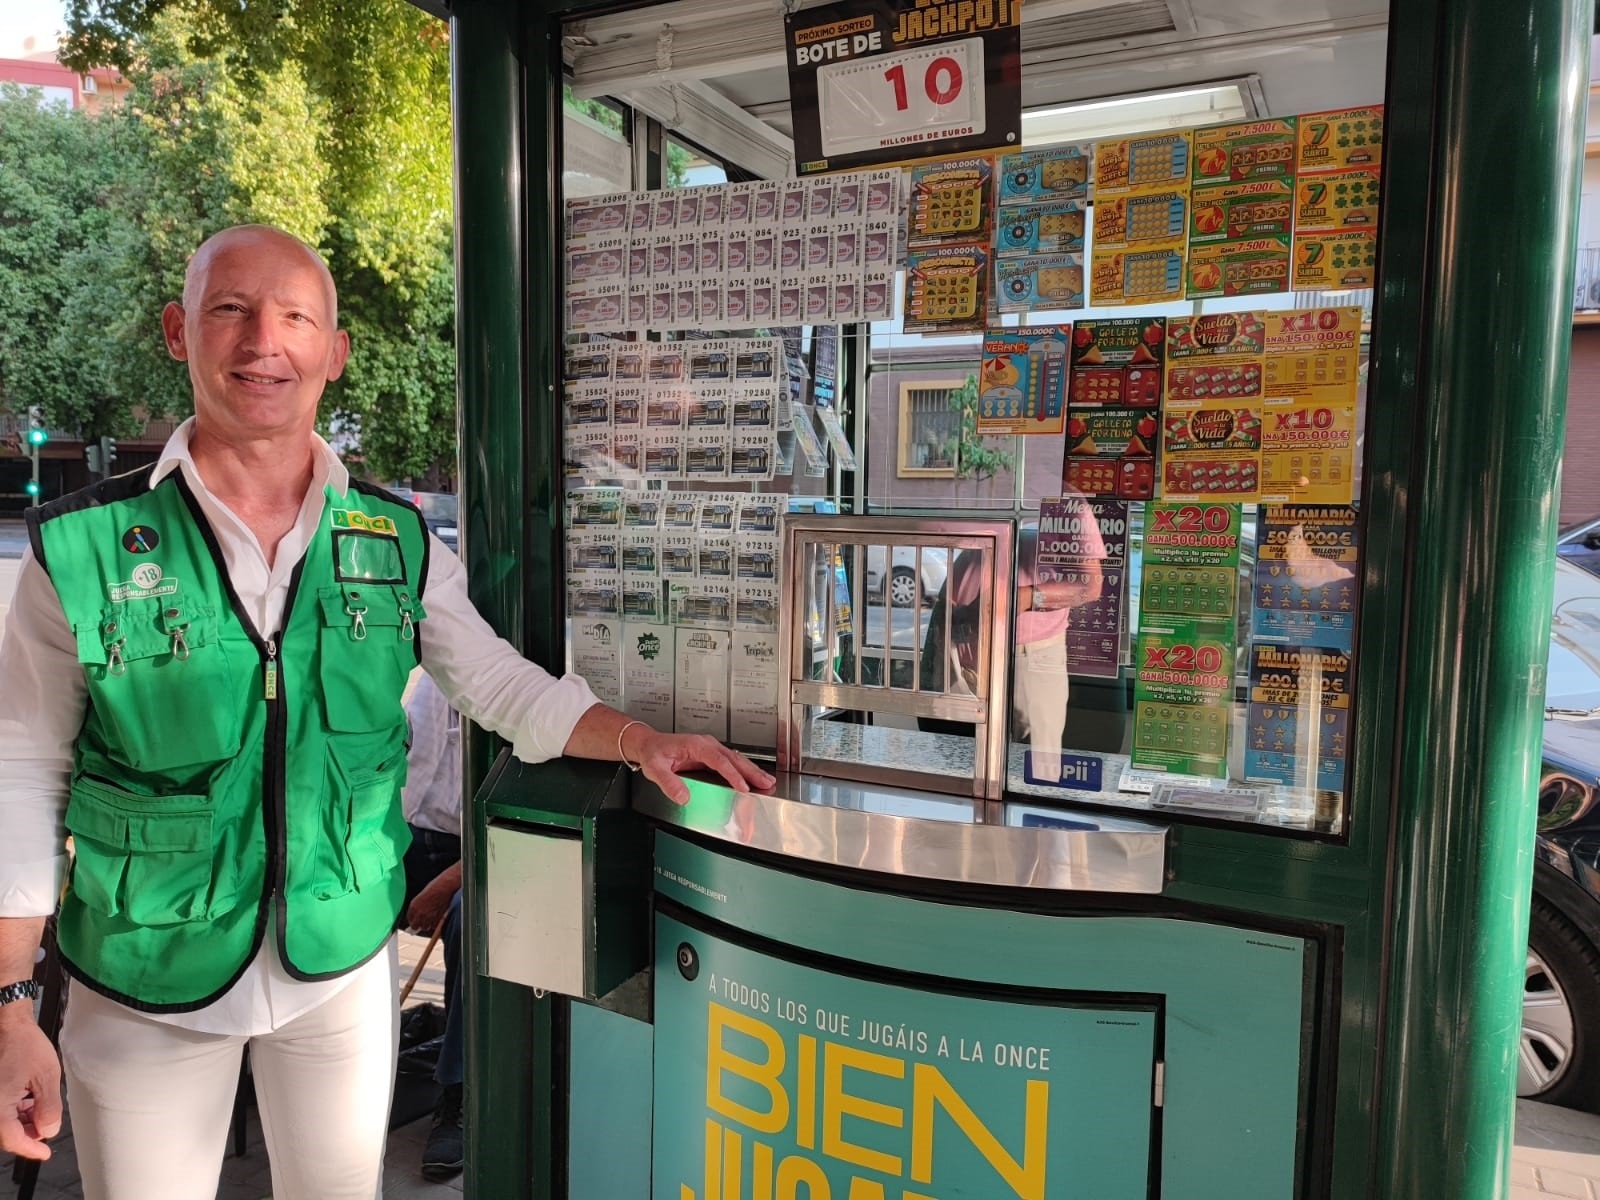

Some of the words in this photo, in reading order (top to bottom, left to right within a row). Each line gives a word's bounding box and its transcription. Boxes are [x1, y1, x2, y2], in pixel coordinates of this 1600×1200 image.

[798, 27, 835, 42] PRÓXIMO
[837, 19, 872, 33] SORTEO
[796, 41, 849, 65] BOTE
[853, 31, 882, 54] DE
[880, 133, 924, 147] MILLONES
[927, 131, 939, 140] DE
[941, 126, 974, 138] EUROS
[1310, 123, 1329, 145] 7
[1307, 184, 1326, 205] 7
[1304, 244, 1324, 264] 7
[1196, 316, 1236, 332] Sueldo
[1280, 310, 1340, 333] x10
[1099, 327, 1138, 337] GALLETA
[1198, 332, 1231, 344] Vida
[1284, 330, 1356, 344] 150.000€
[1097, 338, 1139, 347] FORTUNA
[1093, 419, 1132, 428] GALLETA
[1193, 411, 1232, 427] Sueldo
[1276, 408, 1335, 432] x10
[1092, 429, 1132, 438] FORTUNA
[1195, 427, 1226, 439] Vida
[1280, 430, 1350, 442] 150.000€
[1064, 500, 1105, 514] Mea
[352, 515, 391, 530] ONCE
[1150, 506, 1230, 533] x20
[1264, 508, 1356, 526] MILLONARIO
[1146, 534, 1170, 544] GANA
[1170, 534, 1236, 548] 500.000€
[1153, 548, 1189, 556] Multiplica
[1202, 550, 1229, 558] premio
[638, 643, 660, 652] Once
[1143, 644, 1222, 673] x20
[1257, 651, 1348, 672] MILLONARIO
[1139, 670, 1162, 682] GANA
[1162, 671, 1229, 689] 500.000€
[678, 876, 728, 903] RESPONSABLEMENTE
[708, 973, 717, 993] A
[722, 977, 770, 1014] TODOS
[777, 998, 807, 1025] LOS
[815, 1008, 850, 1037] QUE
[857, 1019, 929, 1054] JUGÁIS
[937, 1034, 949, 1058] A
[960, 1038, 983, 1063] LA
[993, 1043, 1051, 1071] ONCE
[706, 1001, 1049, 1200] BIEN
